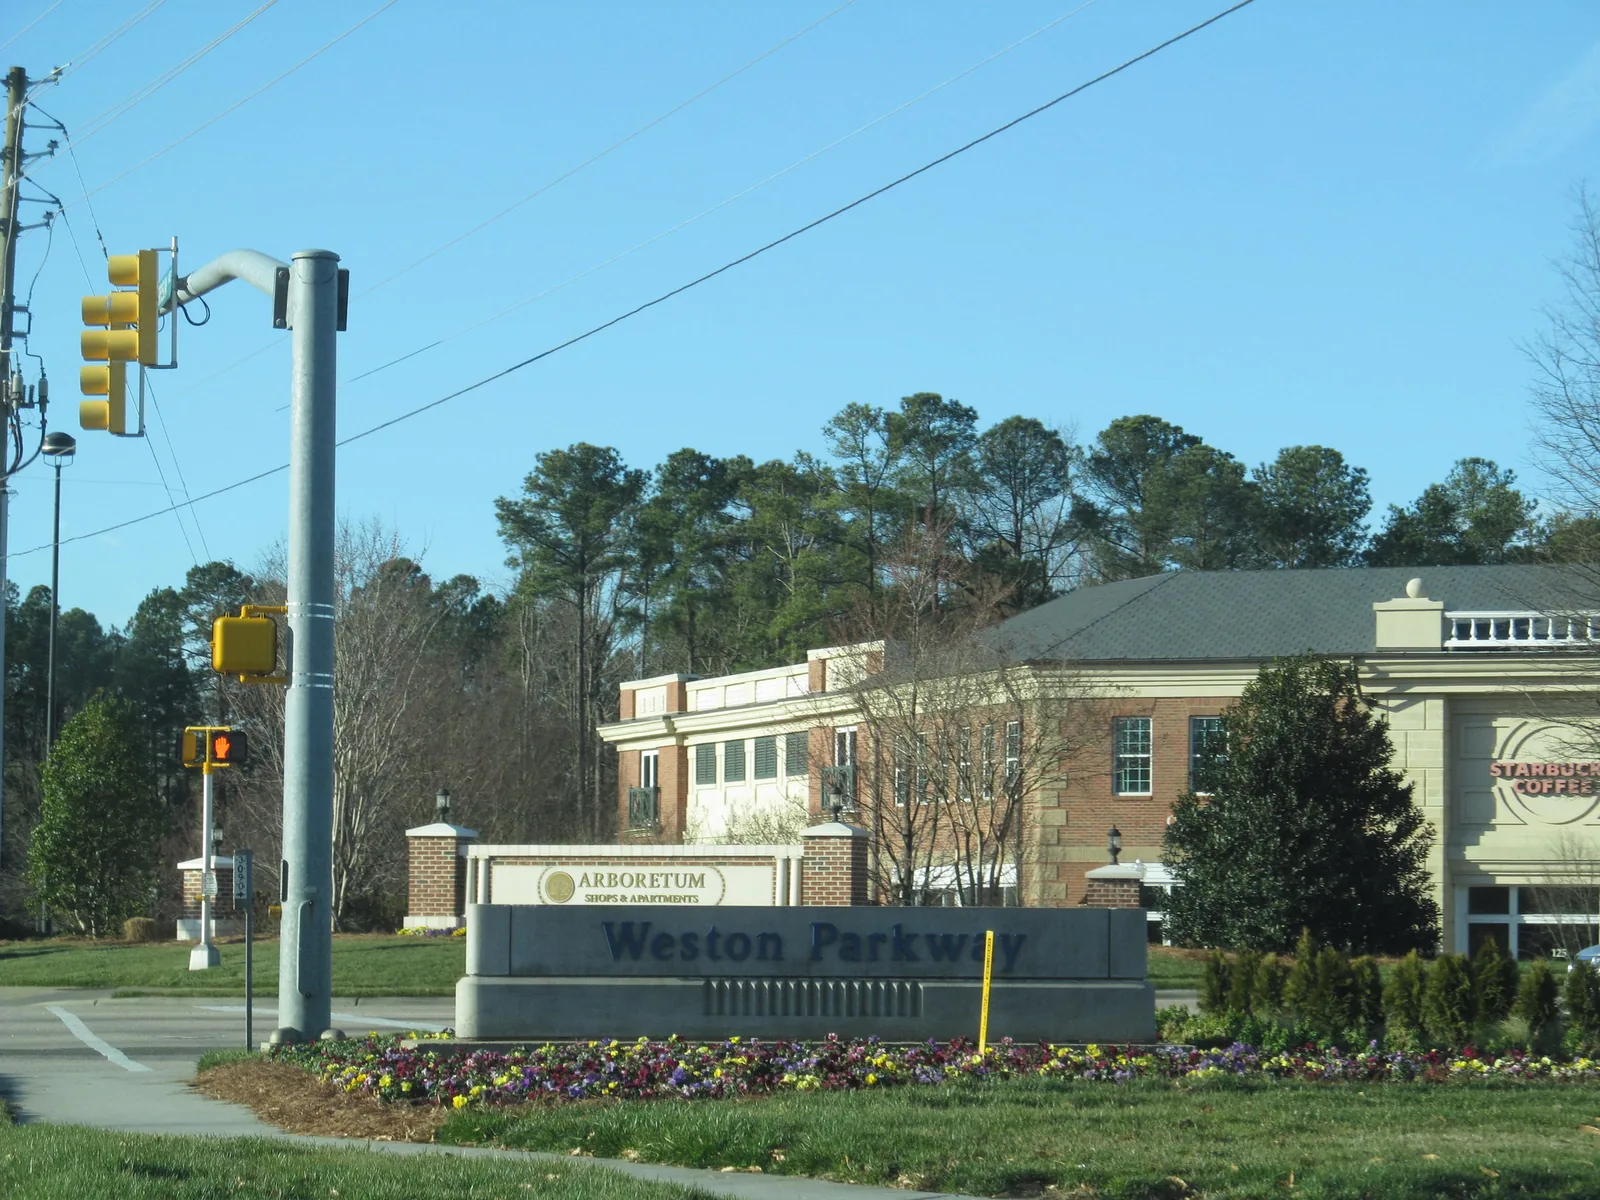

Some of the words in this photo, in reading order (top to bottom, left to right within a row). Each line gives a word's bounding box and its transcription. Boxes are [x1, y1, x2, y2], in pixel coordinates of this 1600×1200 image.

[1513, 780, 1592, 794] COFFEE
[579, 873, 706, 888] ARBORETUM
[584, 894, 618, 903] SHOPS
[620, 894, 628, 903] &
[629, 894, 699, 904] APARTMENTS
[601, 921, 785, 962] Weston
[809, 922, 1026, 973] Parkway
[1551, 948, 1568, 958] 125
